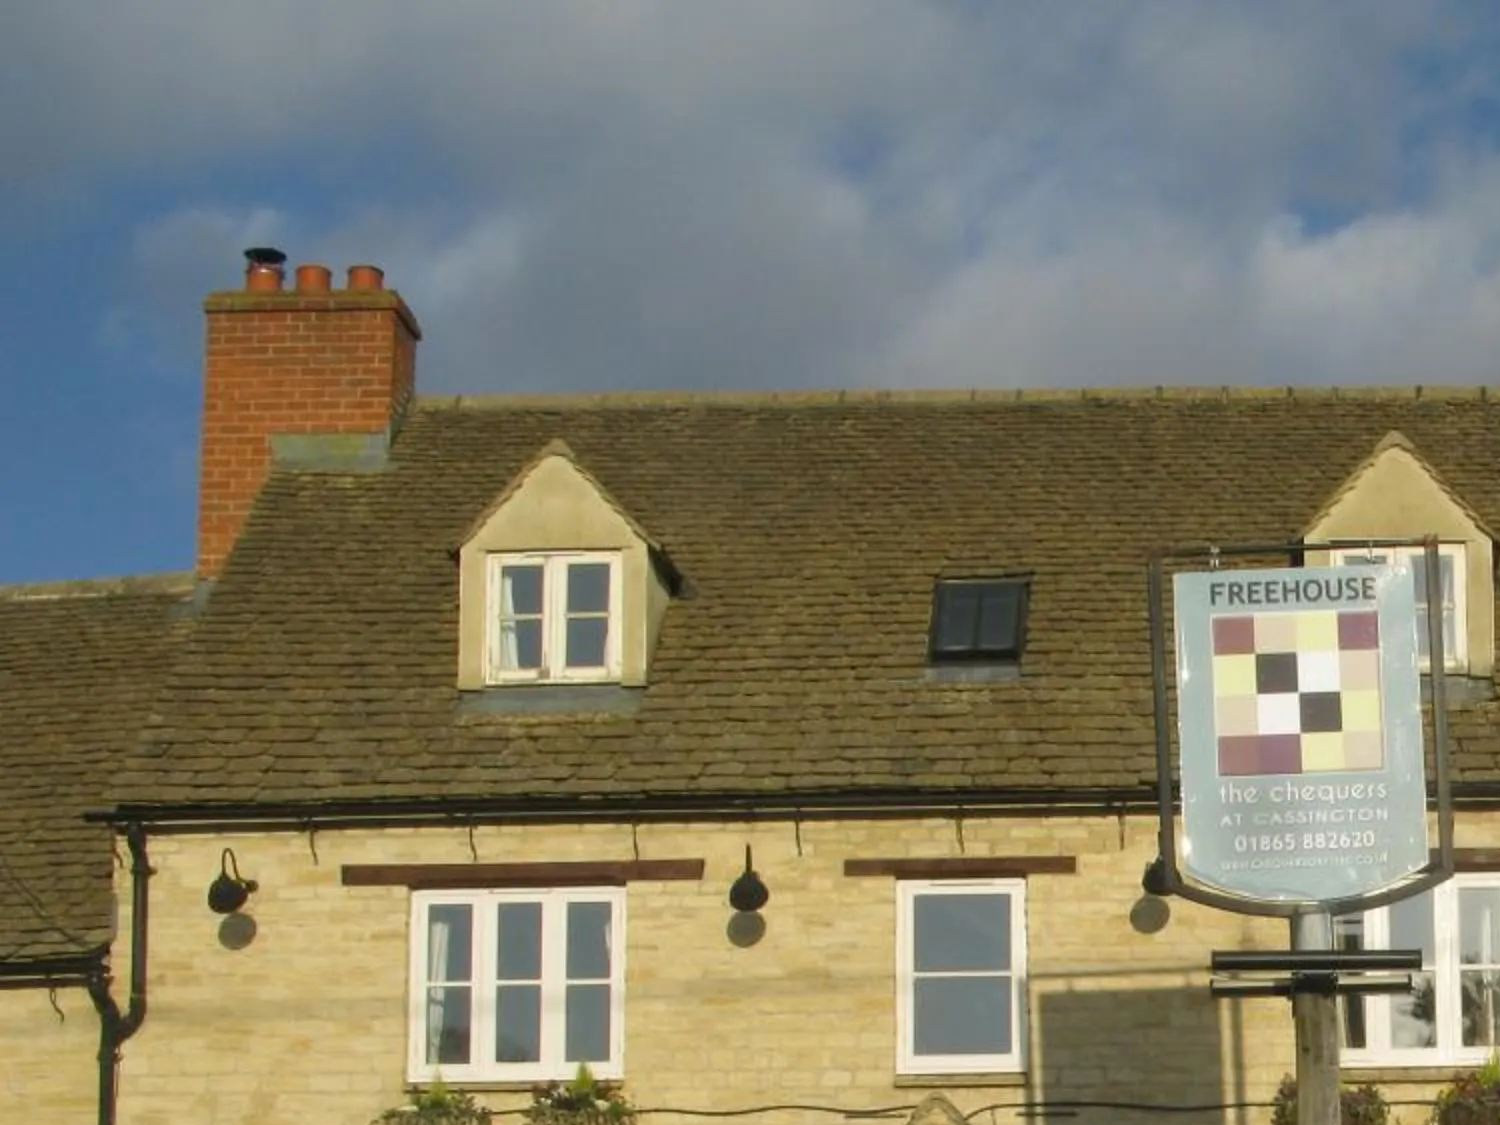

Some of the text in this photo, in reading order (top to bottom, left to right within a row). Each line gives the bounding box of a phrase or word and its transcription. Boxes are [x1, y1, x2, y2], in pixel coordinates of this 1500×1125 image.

[1209, 577, 1377, 606] FREEHOUSE
[1220, 781, 1387, 805] the chequers
[1220, 807, 1389, 829] AT CASSINGTON
[1234, 829, 1376, 852] 01865 882620
